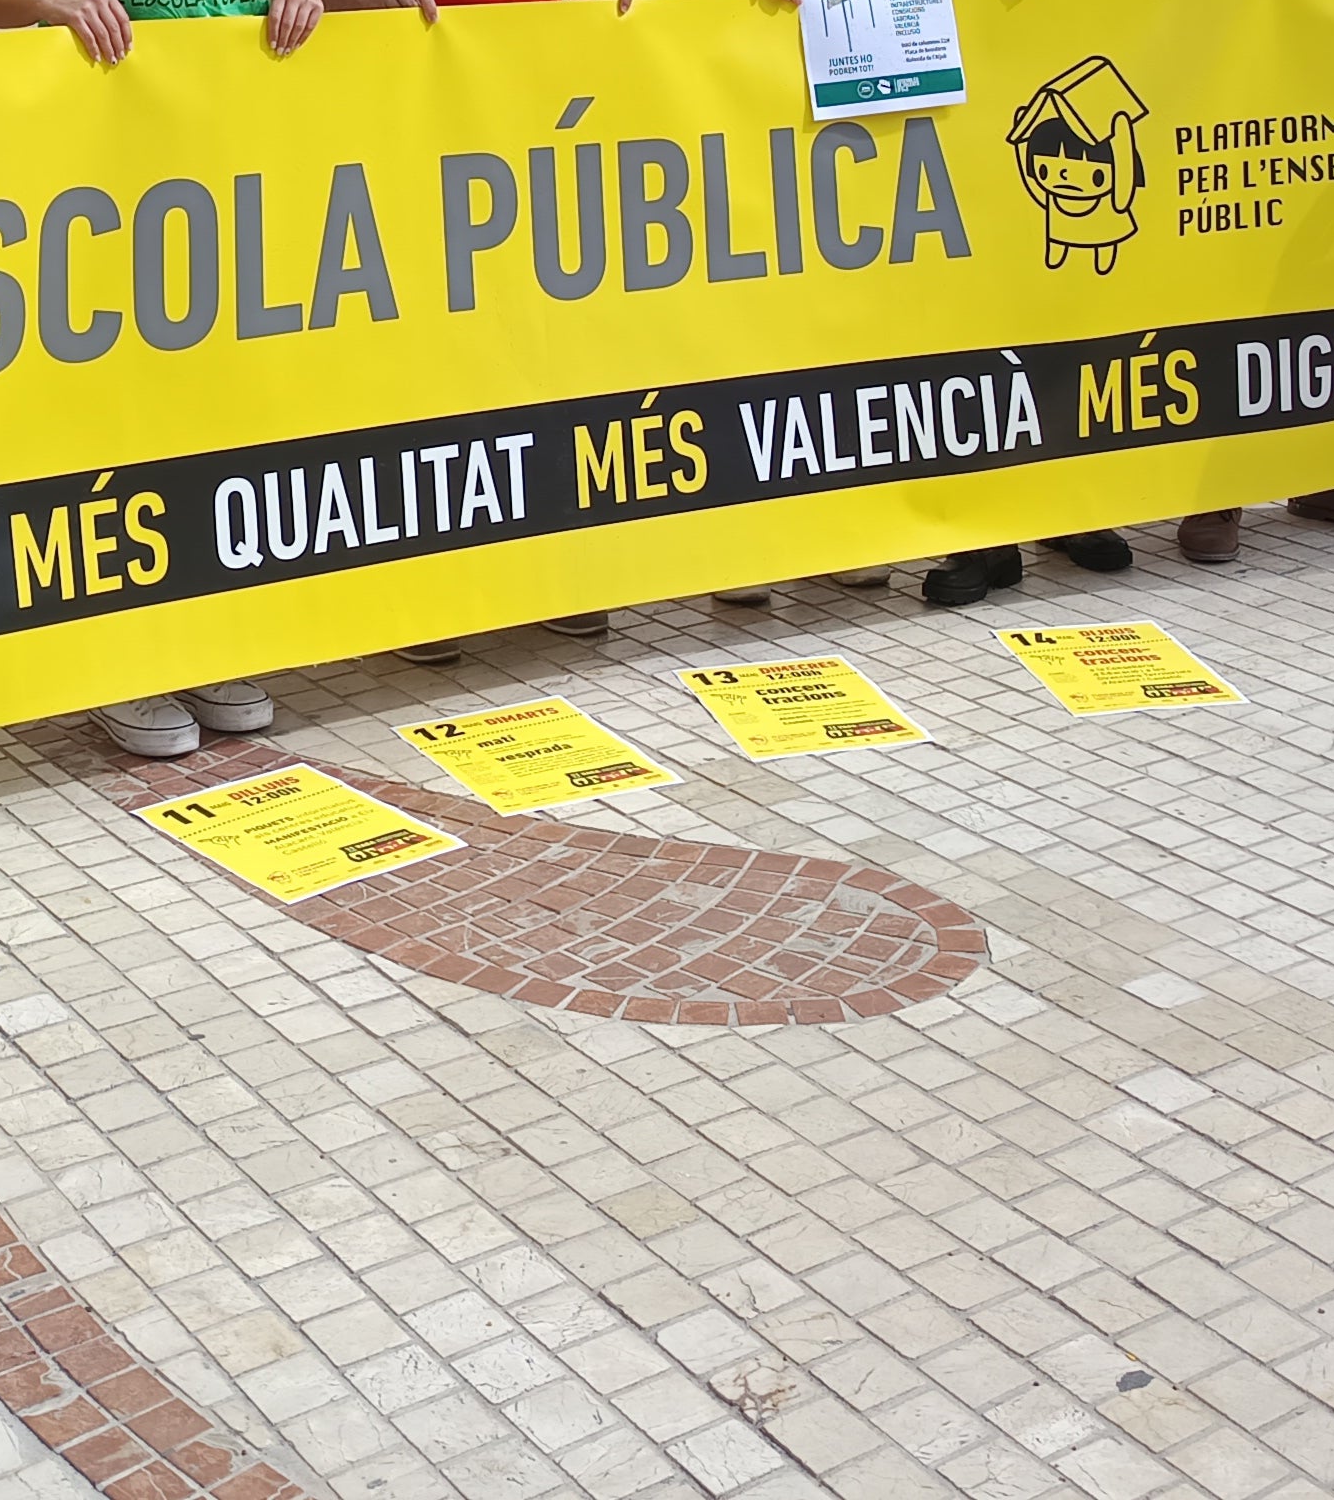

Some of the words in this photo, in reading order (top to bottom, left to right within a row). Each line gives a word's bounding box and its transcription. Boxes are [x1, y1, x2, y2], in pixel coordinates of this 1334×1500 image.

[829, 55, 859, 68] JUNTES
[860, 54, 873, 63] HO
[829, 66, 857, 76] PODREM
[1177, 161, 1229, 196] PER
[439, 96, 973, 314] PÚBLICA
[1178, 198, 1285, 236] PÚBLIC
[9, 471, 169, 609] MÉS
[213, 431, 535, 571] QUALITAT
[573, 392, 710, 509] MÉS
[739, 349, 1045, 483] VALENCIÀ
[1077, 331, 1199, 438] MÉS
[1010, 632, 1057, 647] 14
[1079, 628, 1135, 638] DIJOUS
[1086, 634, 1141, 644] 12:00h
[1073, 646, 1151, 658] concen-
[1079, 653, 1162, 666] tracions
[692, 671, 739, 686] 13
[758, 660, 839, 675] DIMECRES
[766, 670, 823, 681] 12:00h
[755, 682, 837, 696] concen-
[762, 690, 847, 705] tracions
[413, 724, 466, 741] 12
[483, 707, 559, 726] DIMARTS
[477, 734, 517, 748] matí
[495, 742, 574, 762] vesprada
[162, 803, 217, 824] 11
[227, 776, 301, 801] DILLUNS
[241, 786, 302, 806] 12:00h
[243, 816, 295, 834] PIQUETS
[263, 816, 349, 845] MANIFESTACIÓ
